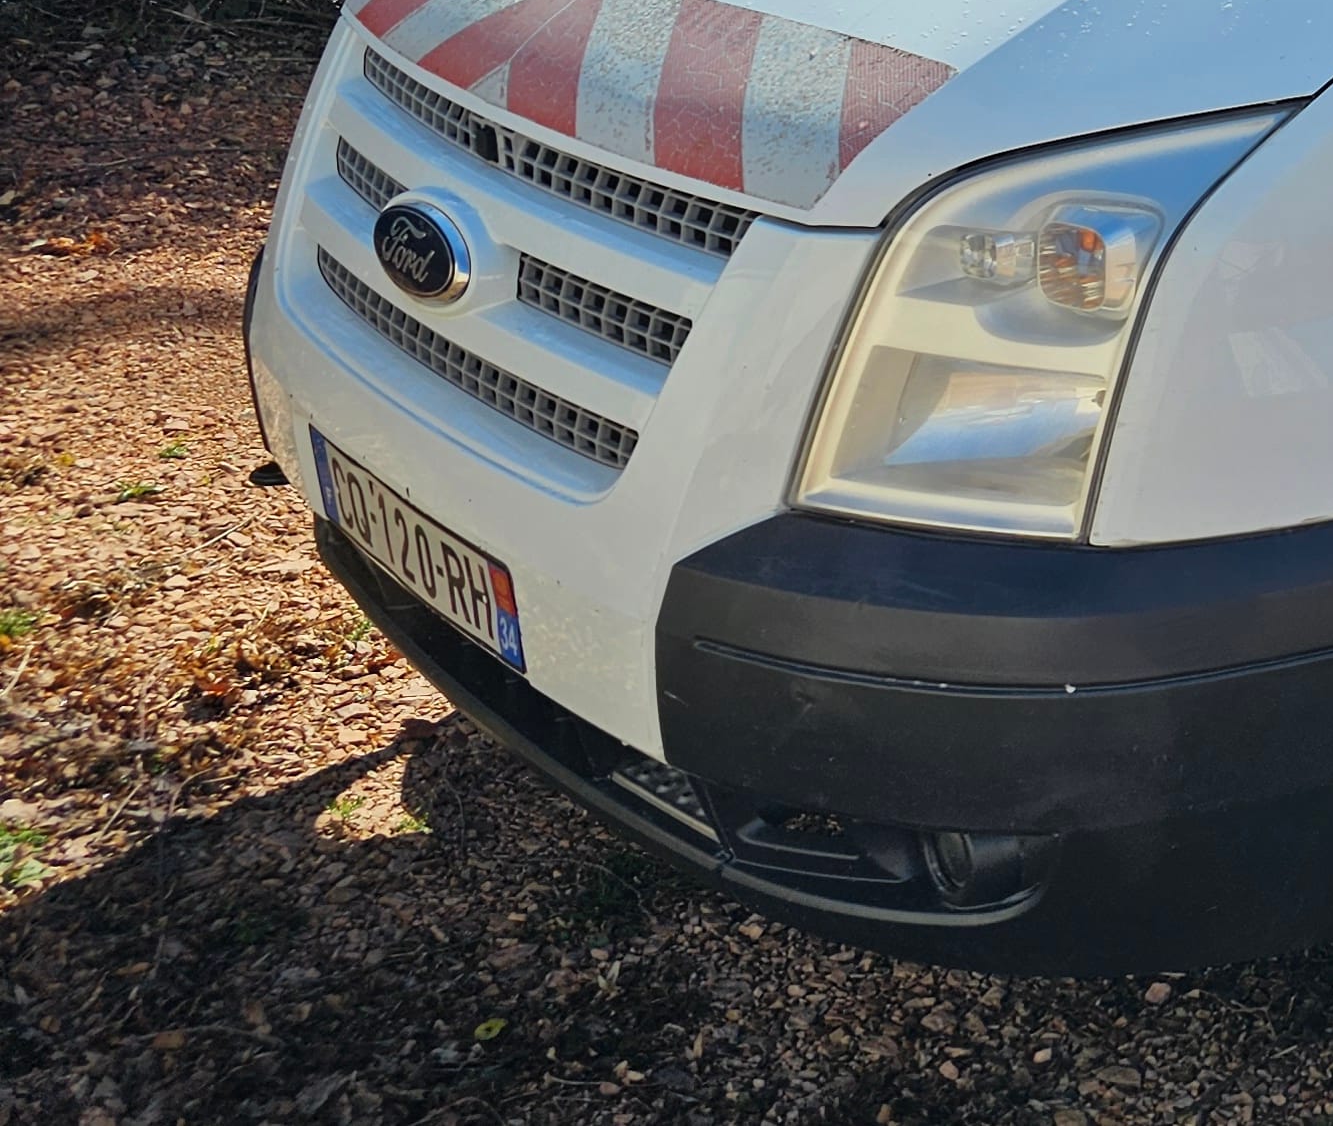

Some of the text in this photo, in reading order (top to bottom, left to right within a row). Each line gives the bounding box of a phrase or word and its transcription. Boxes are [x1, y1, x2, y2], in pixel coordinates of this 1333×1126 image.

[382, 215, 435, 283] Ford
[332, 457, 495, 641] CQ-120-RH
[500, 616, 518, 657] 34
